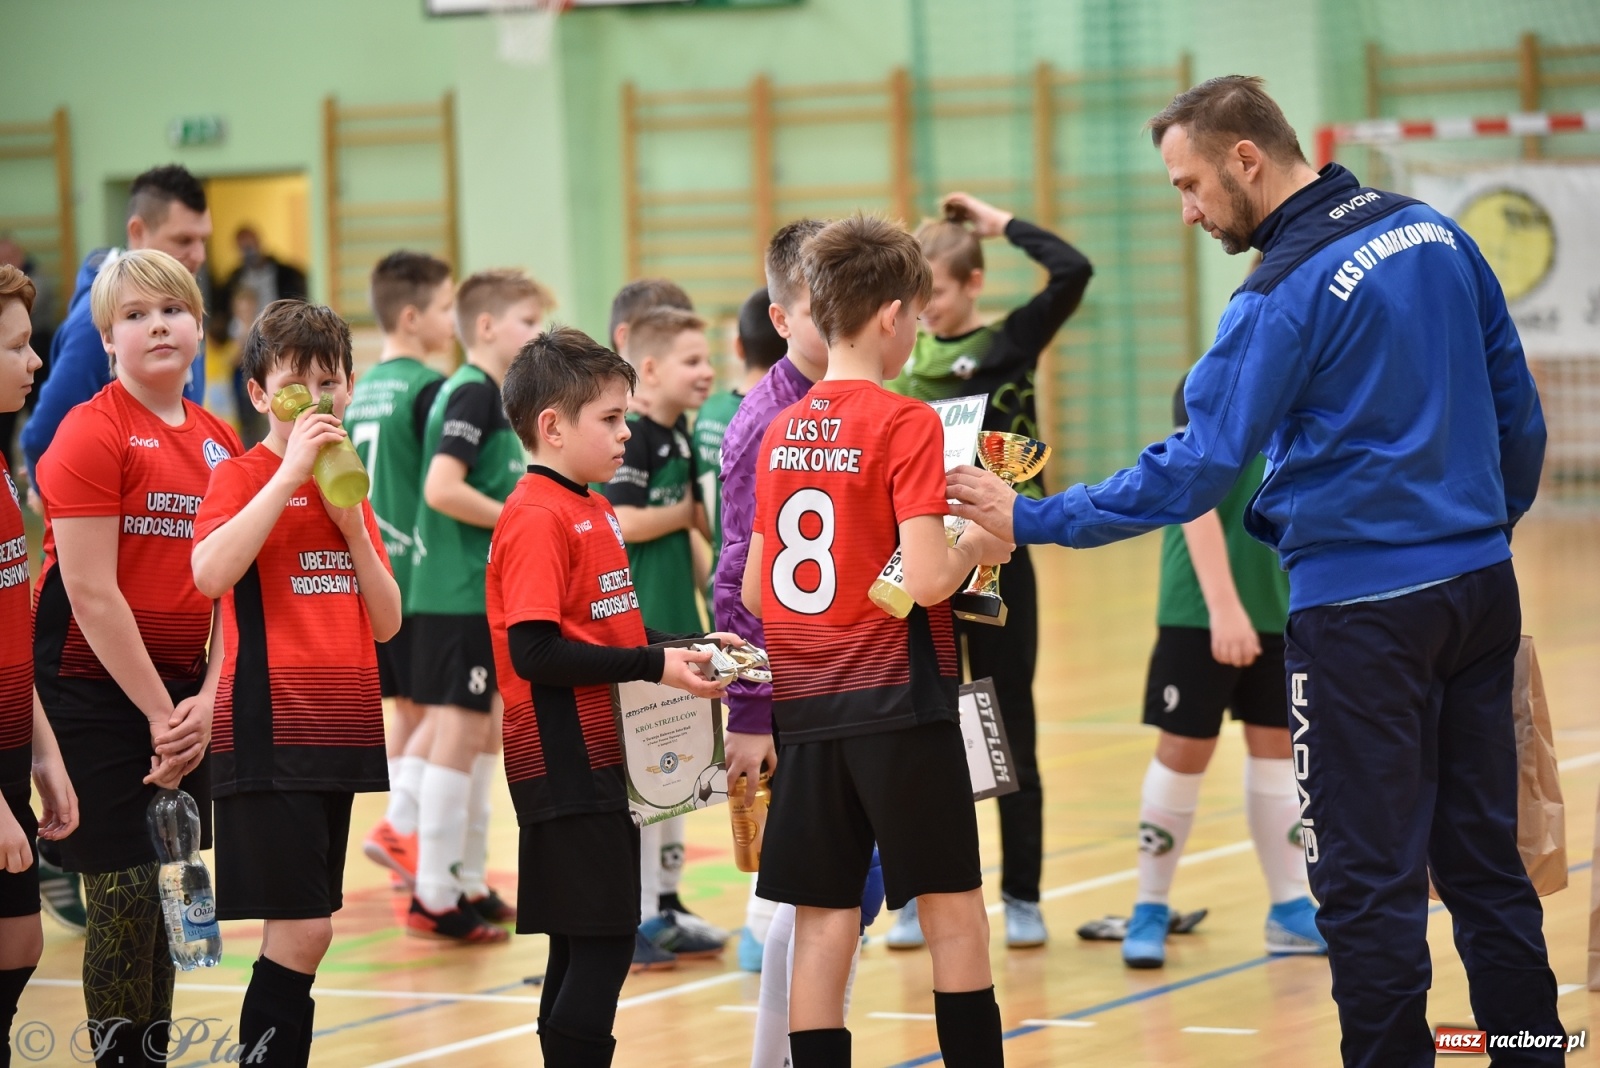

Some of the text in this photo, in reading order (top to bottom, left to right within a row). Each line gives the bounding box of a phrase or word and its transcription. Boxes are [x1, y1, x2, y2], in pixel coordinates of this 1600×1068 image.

[1329, 192, 1381, 219] GIVOVA
[1328, 222, 1457, 302] LKS 07 MARKOWICE
[785, 417, 842, 442] LKS 07
[771, 486, 837, 616] 8
[290, 574, 351, 595] RADOSŁAW
[468, 665, 488, 695] 8
[1163, 684, 1180, 713] 9
[634, 710, 698, 735] KRÓL STRZELCÓW
[975, 692, 1011, 783] DYPLOM
[1291, 672, 1319, 864] GIVOVA
